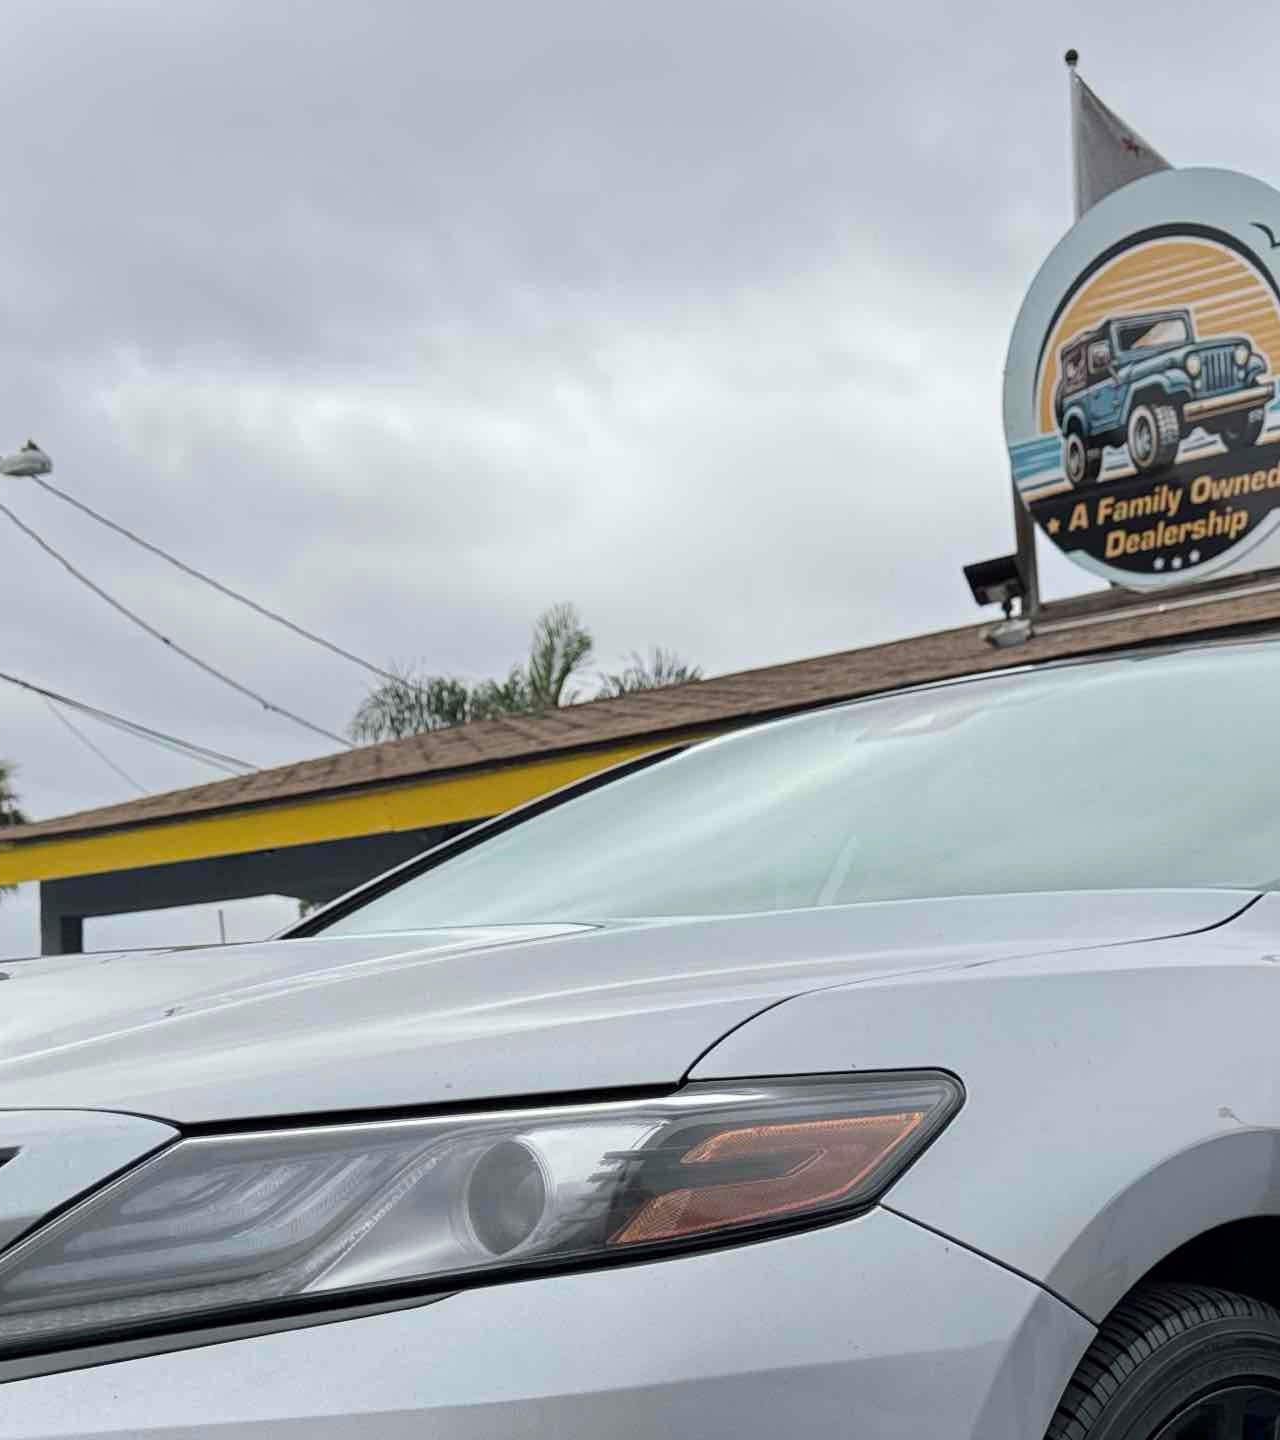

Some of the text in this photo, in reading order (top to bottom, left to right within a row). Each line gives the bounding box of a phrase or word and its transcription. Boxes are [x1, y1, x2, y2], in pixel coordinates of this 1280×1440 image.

[1069, 503, 1088, 531] A
[1097, 484, 1183, 525] Family
[1105, 507, 1249, 559] Dealership
